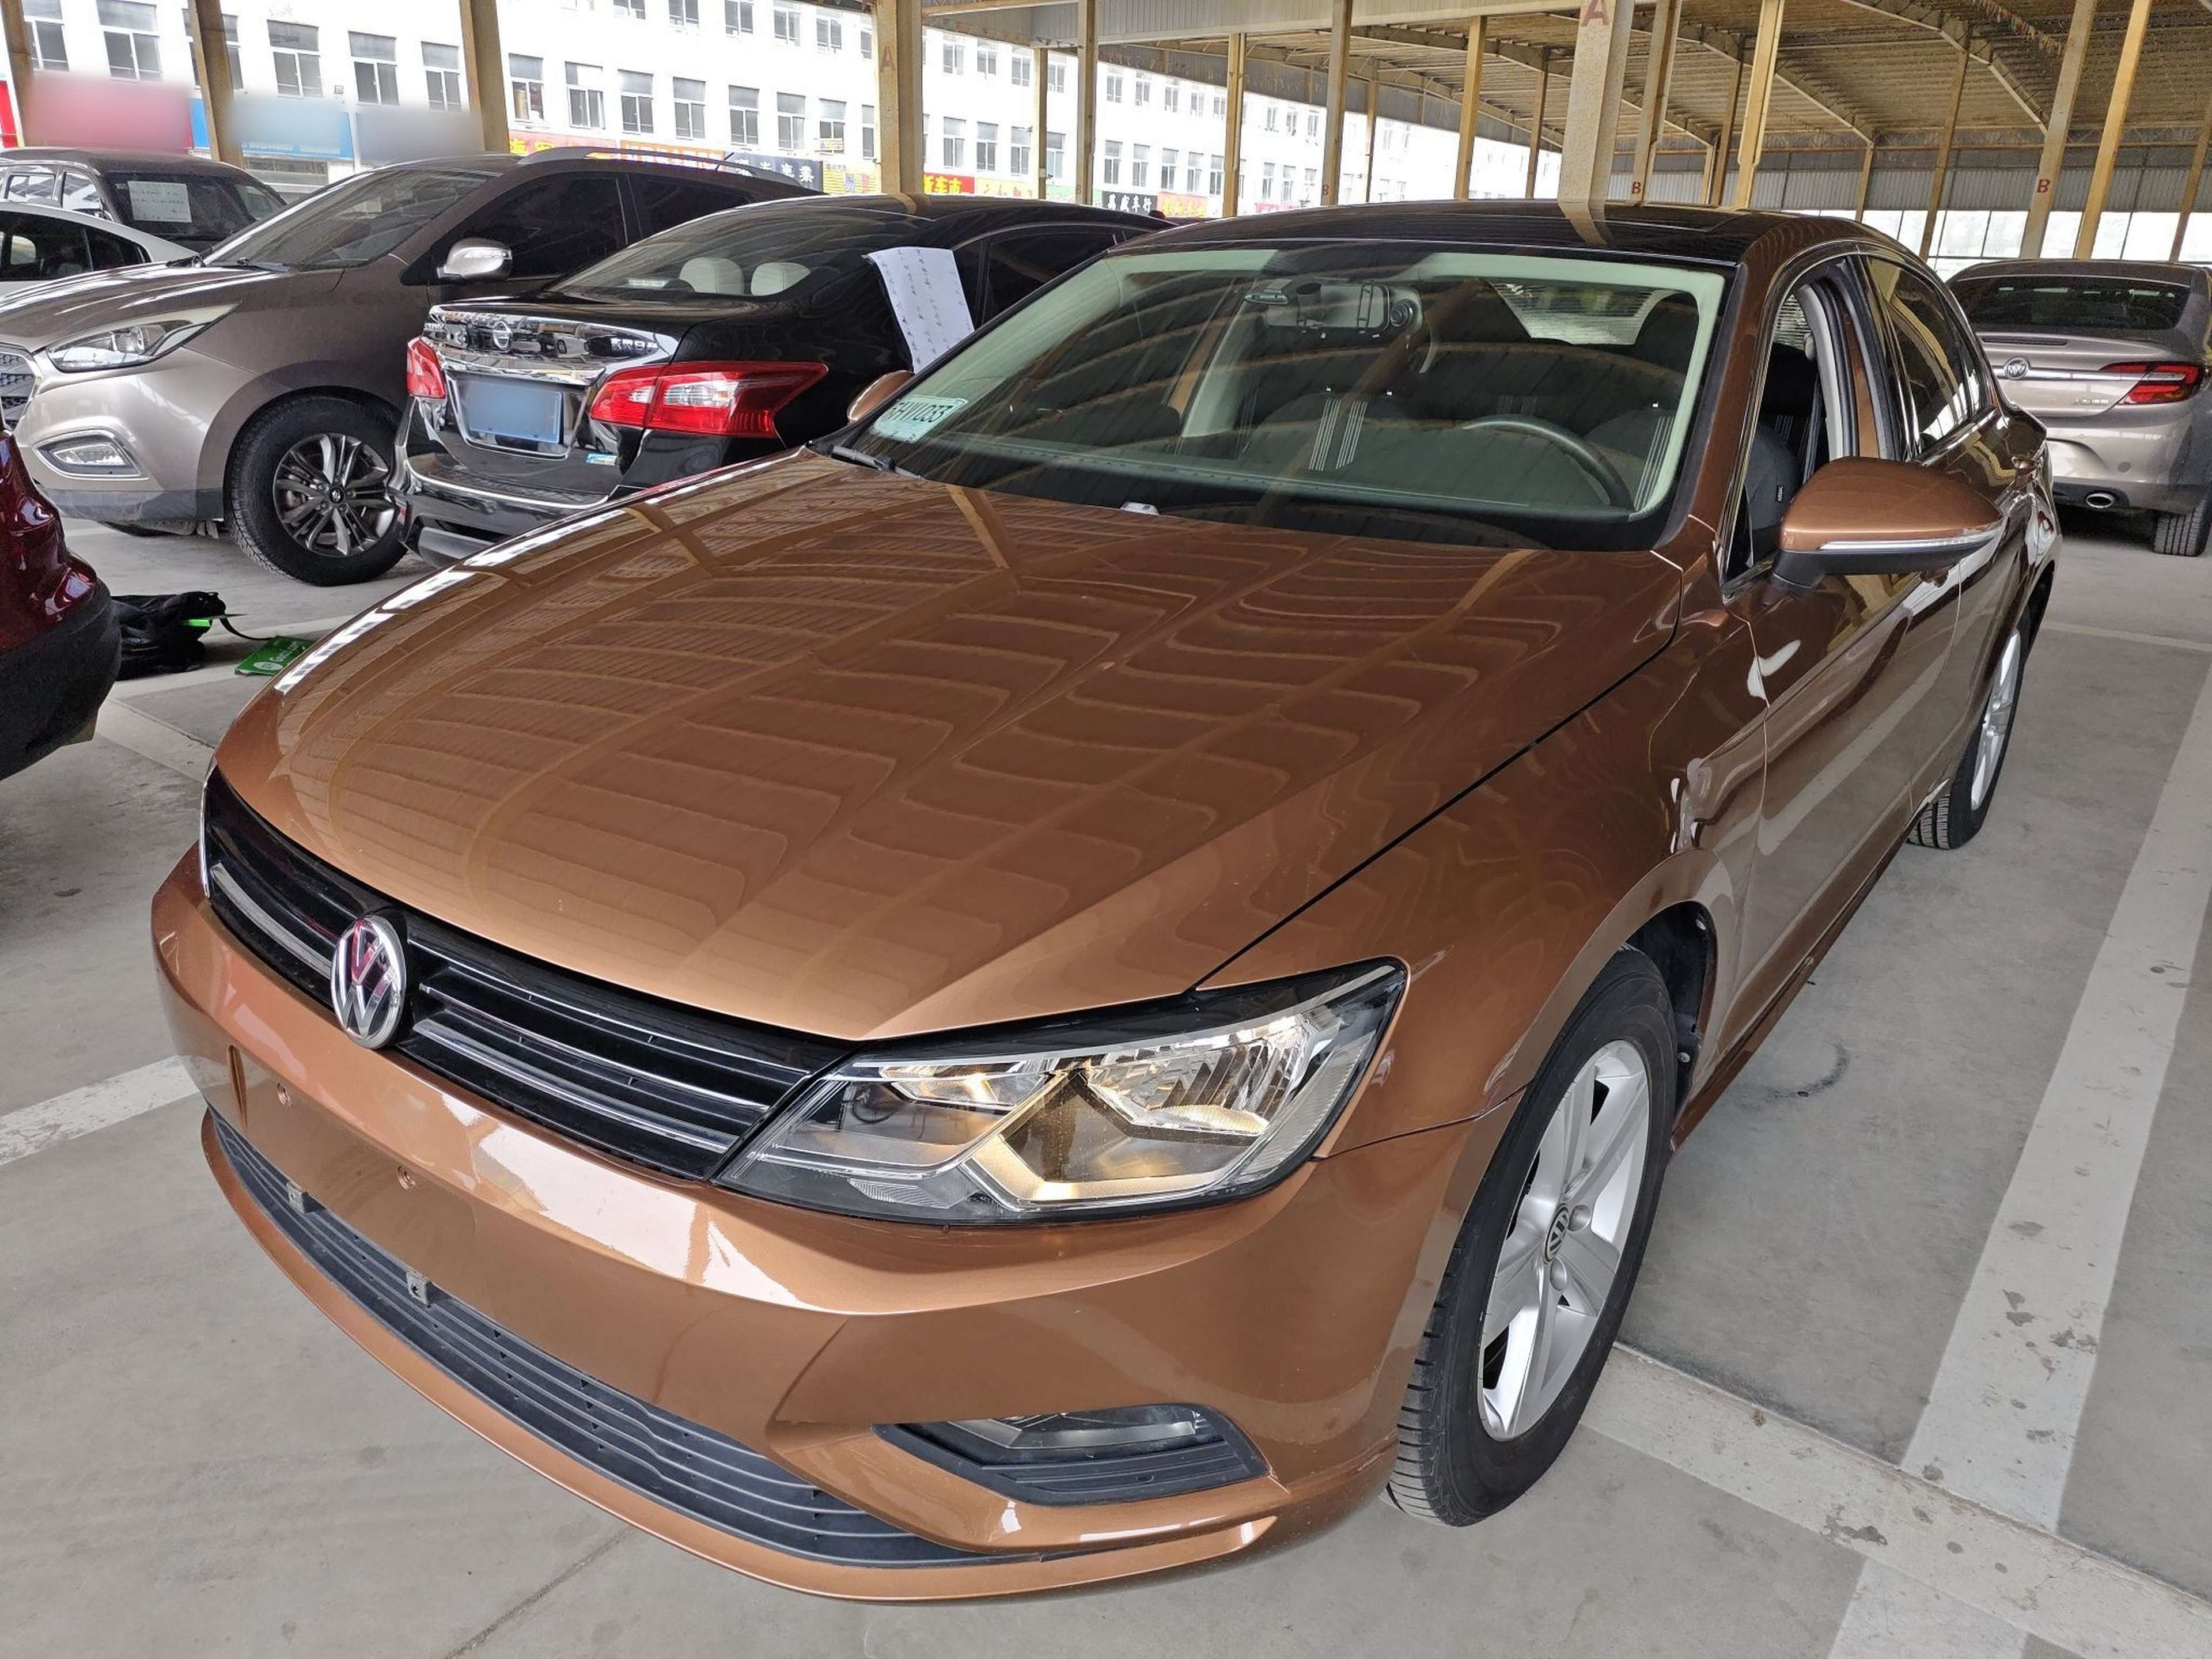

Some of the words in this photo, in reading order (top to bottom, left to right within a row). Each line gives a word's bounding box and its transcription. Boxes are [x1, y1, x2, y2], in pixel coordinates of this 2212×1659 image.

[1322, 184, 1329, 195] B
[1632, 181, 1641, 194] B
[2037, 179, 2050, 193] B
